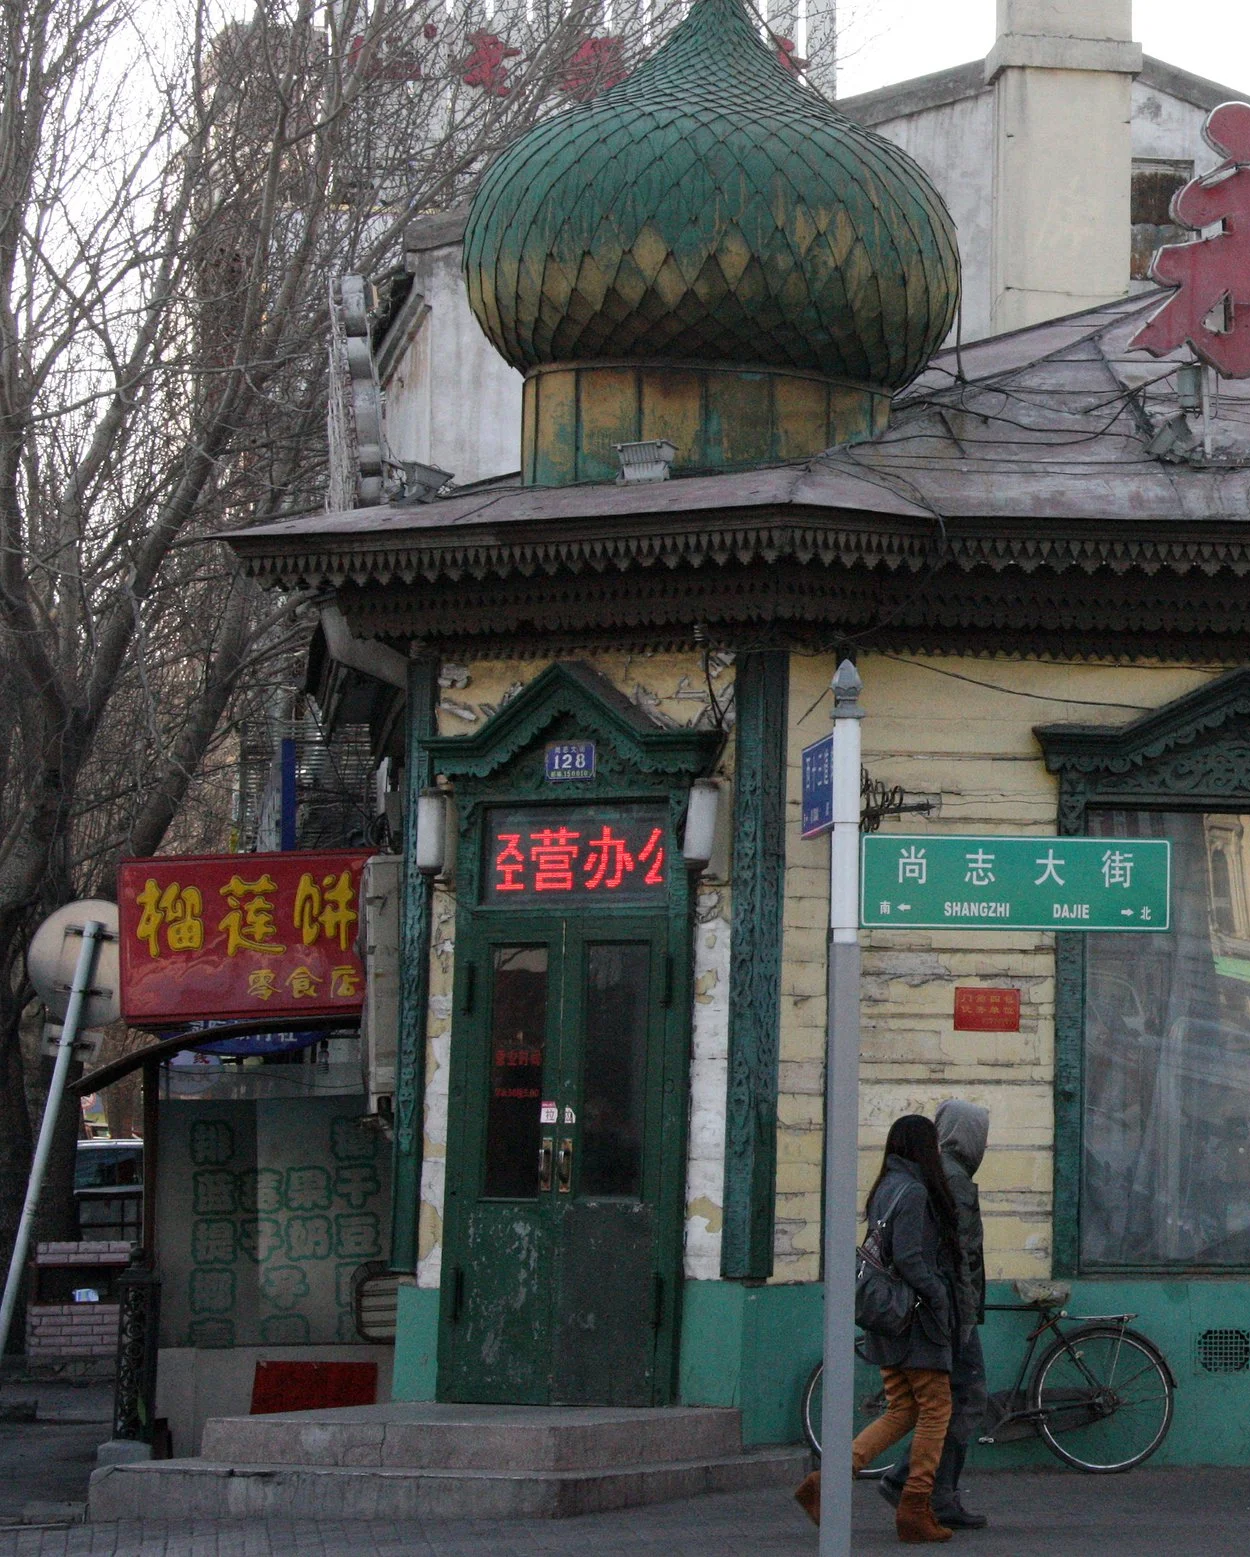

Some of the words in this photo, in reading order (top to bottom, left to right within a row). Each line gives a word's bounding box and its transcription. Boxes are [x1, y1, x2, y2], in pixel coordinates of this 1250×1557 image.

[554, 753, 586, 770] 128
[898, 846, 1134, 888] 尚志大街
[136, 870, 359, 959] 榴莲饼
[879, 901, 891, 914] 南
[943, 902, 1010, 918] SHANGZHI
[1053, 903, 1090, 919] DAJIE
[1140, 906, 1152, 920] 北
[247, 965, 360, 1000] 零食店
